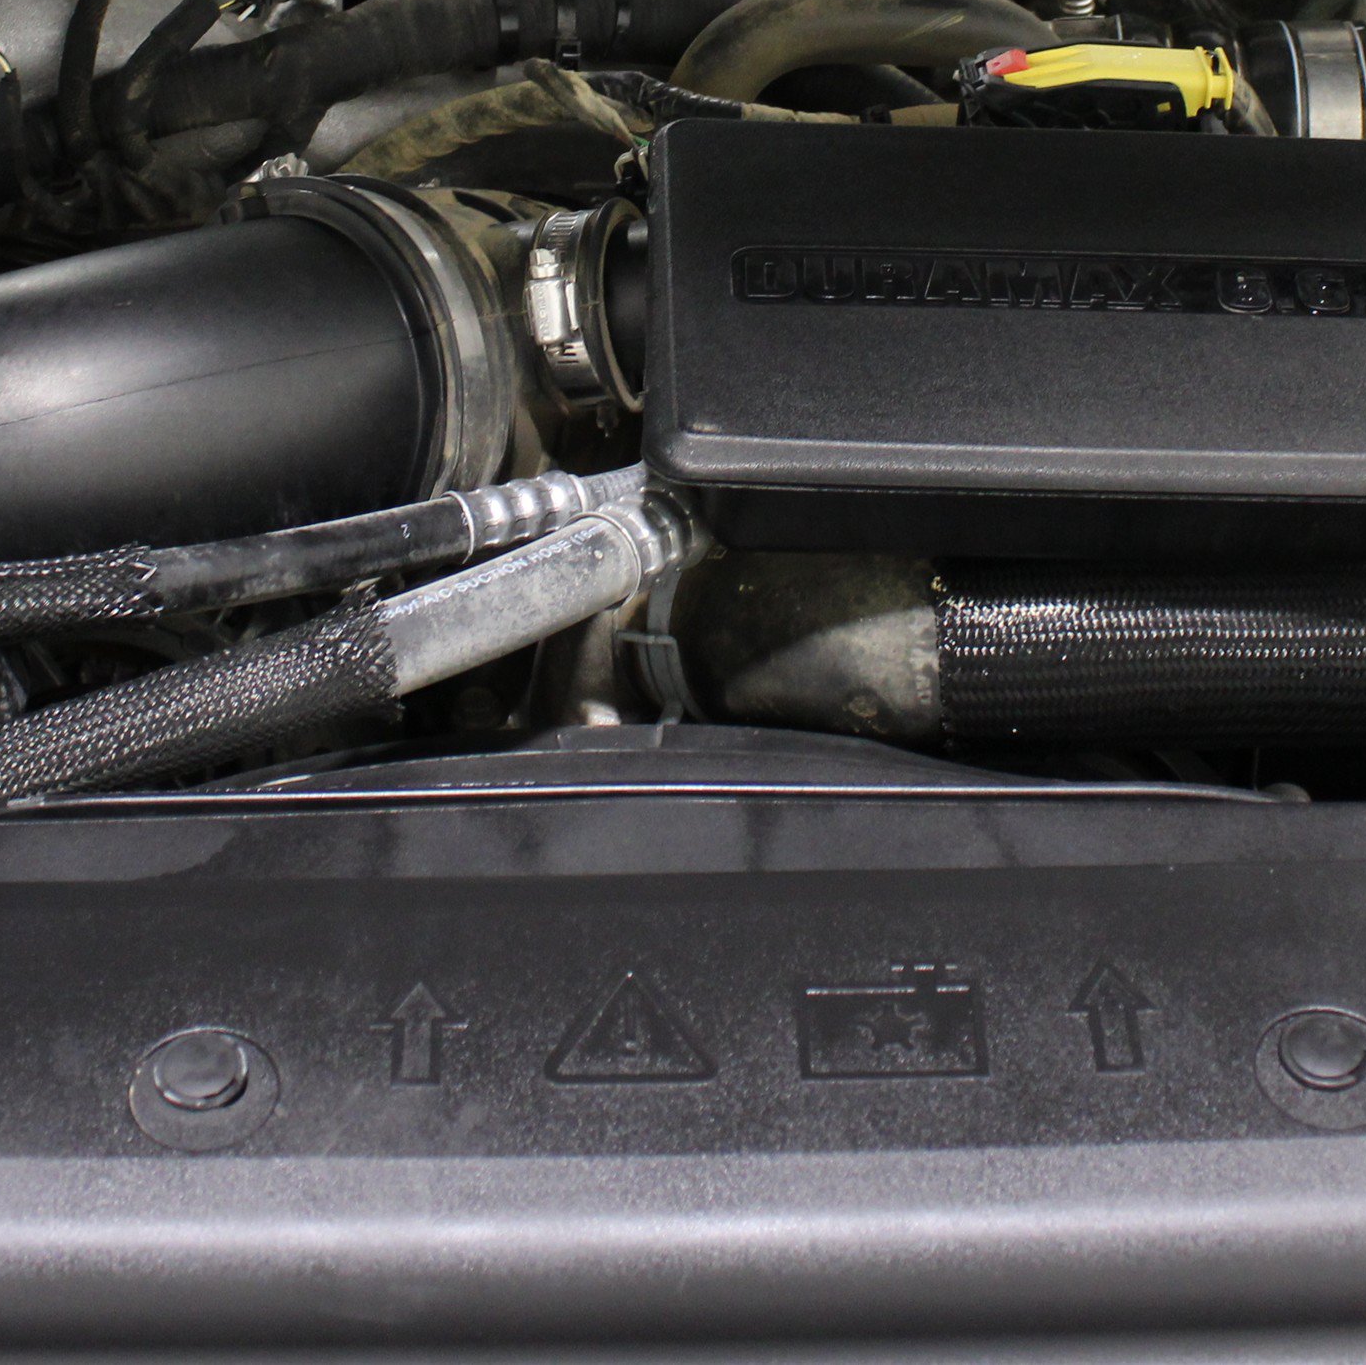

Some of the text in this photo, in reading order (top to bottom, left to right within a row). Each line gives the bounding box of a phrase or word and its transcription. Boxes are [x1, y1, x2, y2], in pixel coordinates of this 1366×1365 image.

[745, 257, 1183, 311] DURAMAX
[1216, 267, 1352, 314] 6.6
[454, 557, 528, 593] SUCTION
[528, 540, 572, 565] HOSE
